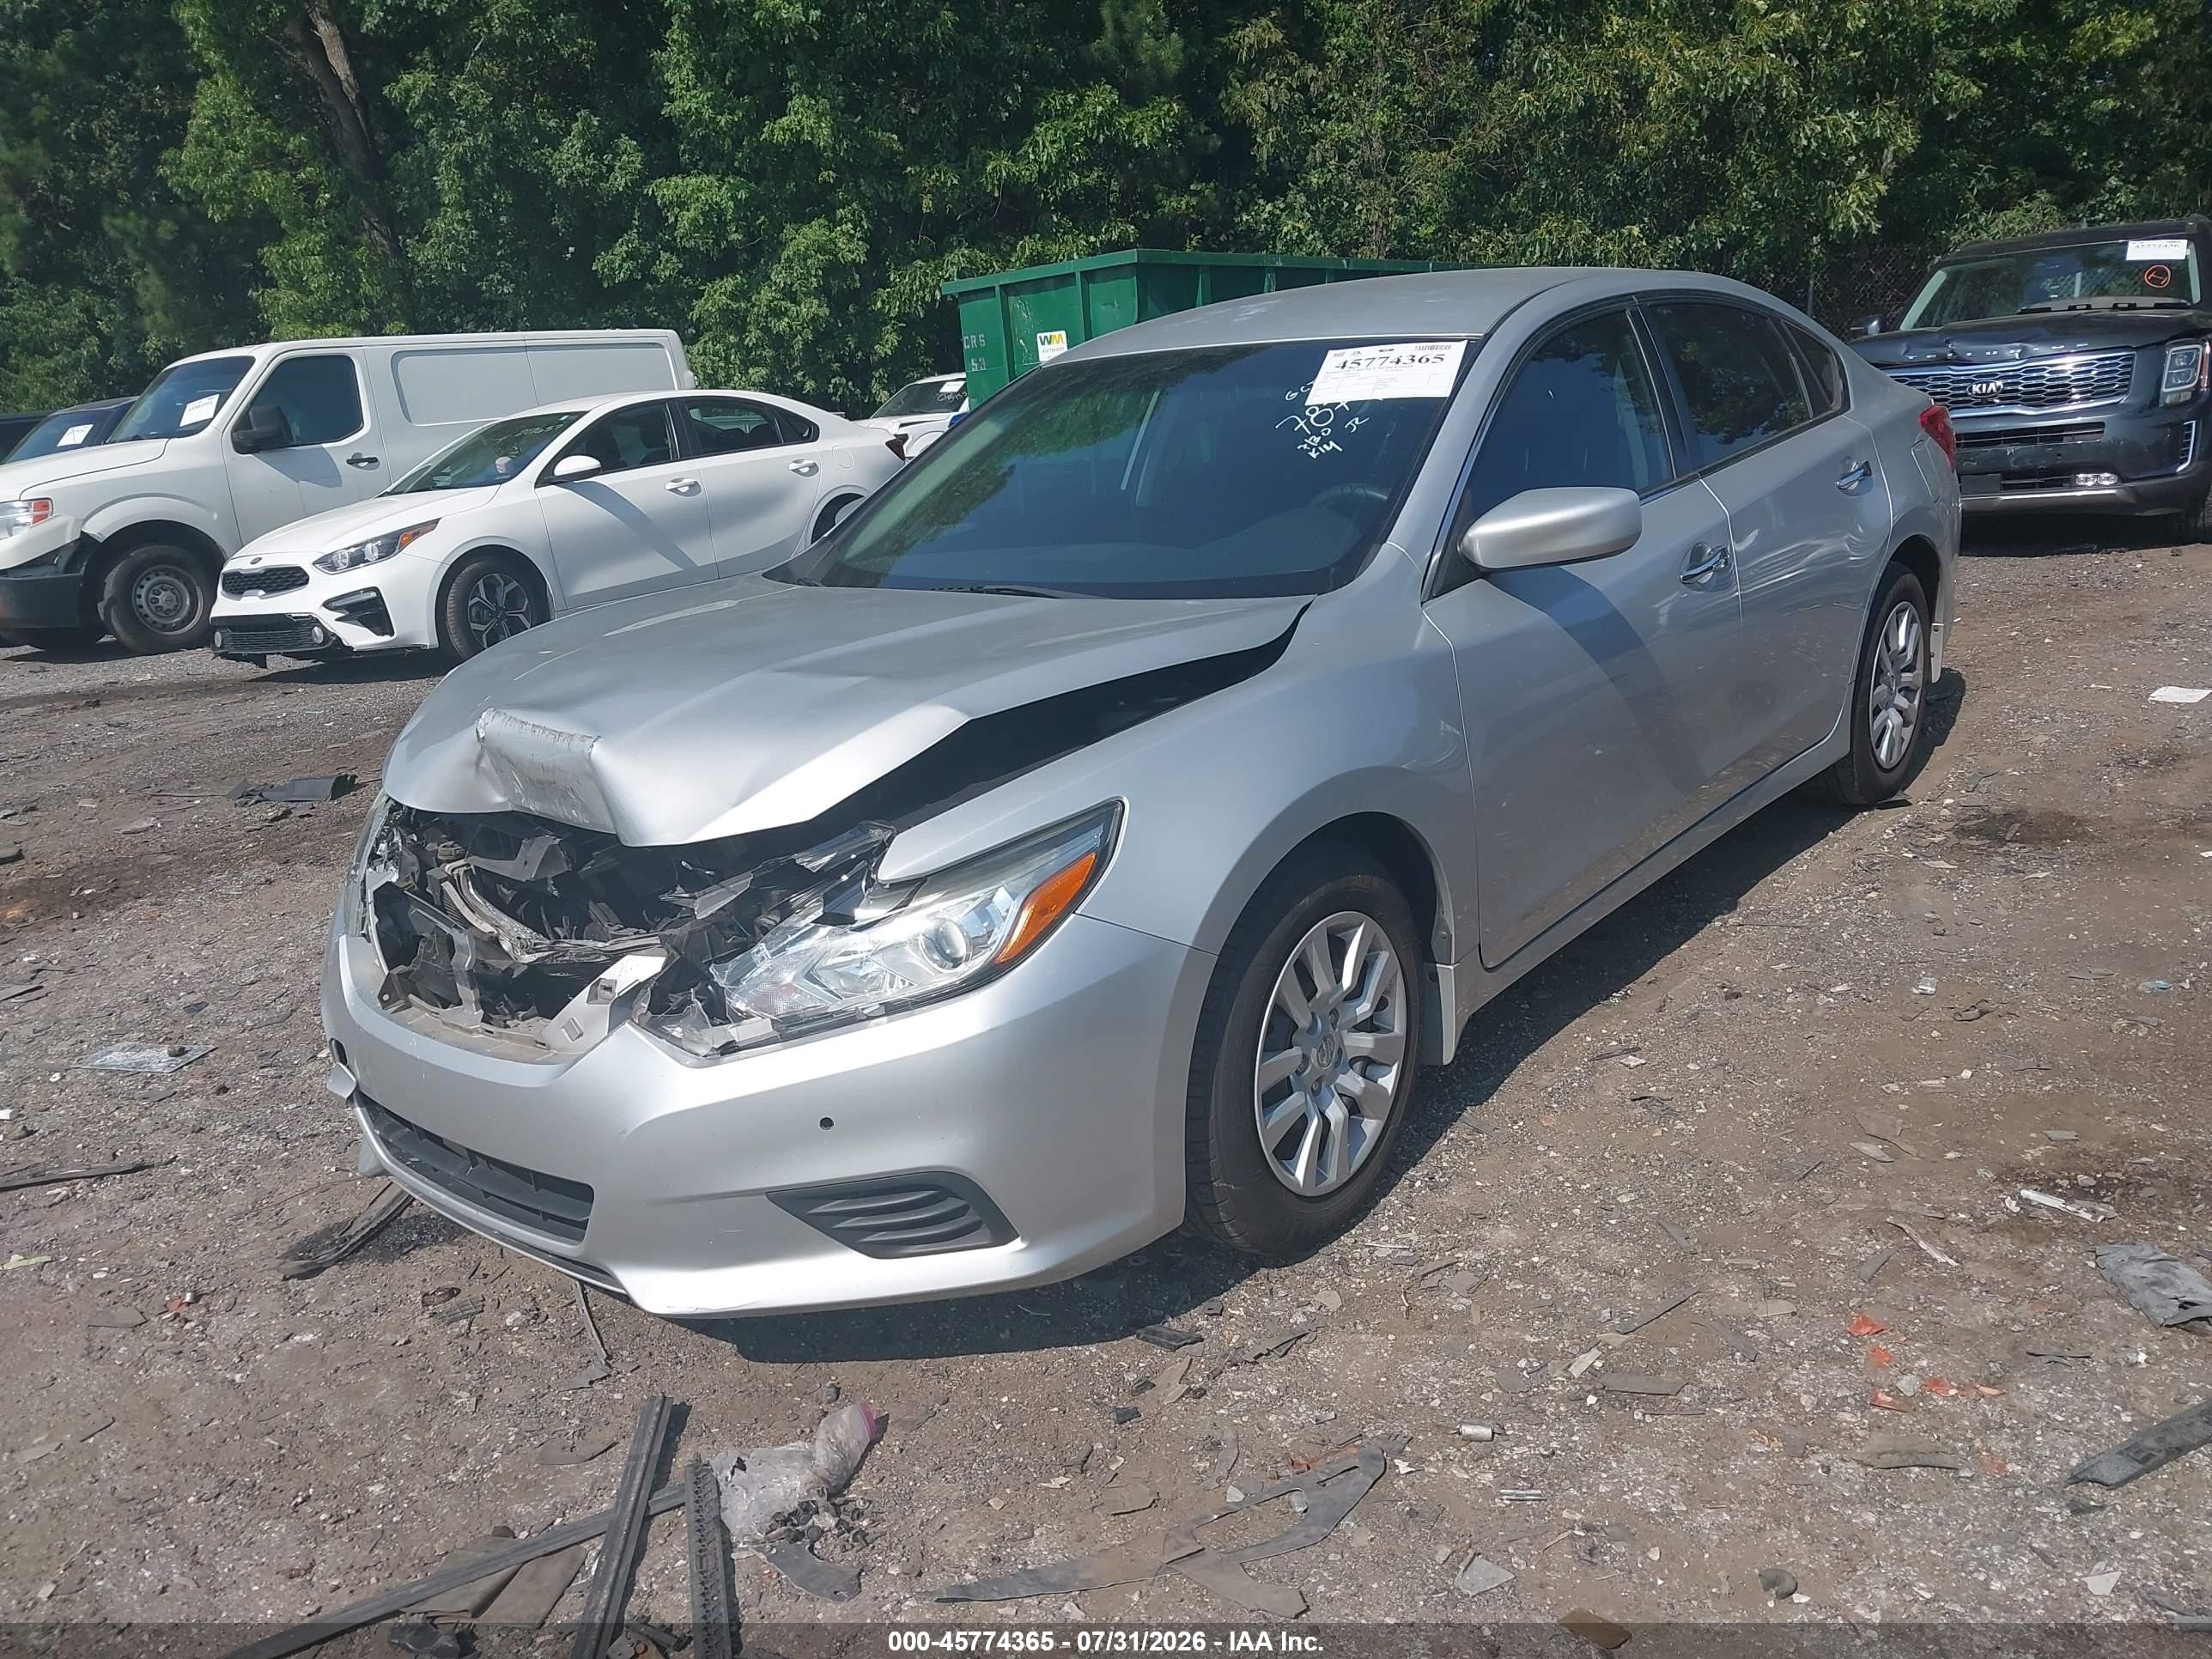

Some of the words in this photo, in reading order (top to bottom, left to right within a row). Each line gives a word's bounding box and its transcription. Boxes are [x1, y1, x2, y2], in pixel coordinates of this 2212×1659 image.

[1039, 333, 1065, 345] WM
[1334, 354, 1445, 370] 45774365
[1972, 382, 1997, 395] KIA
